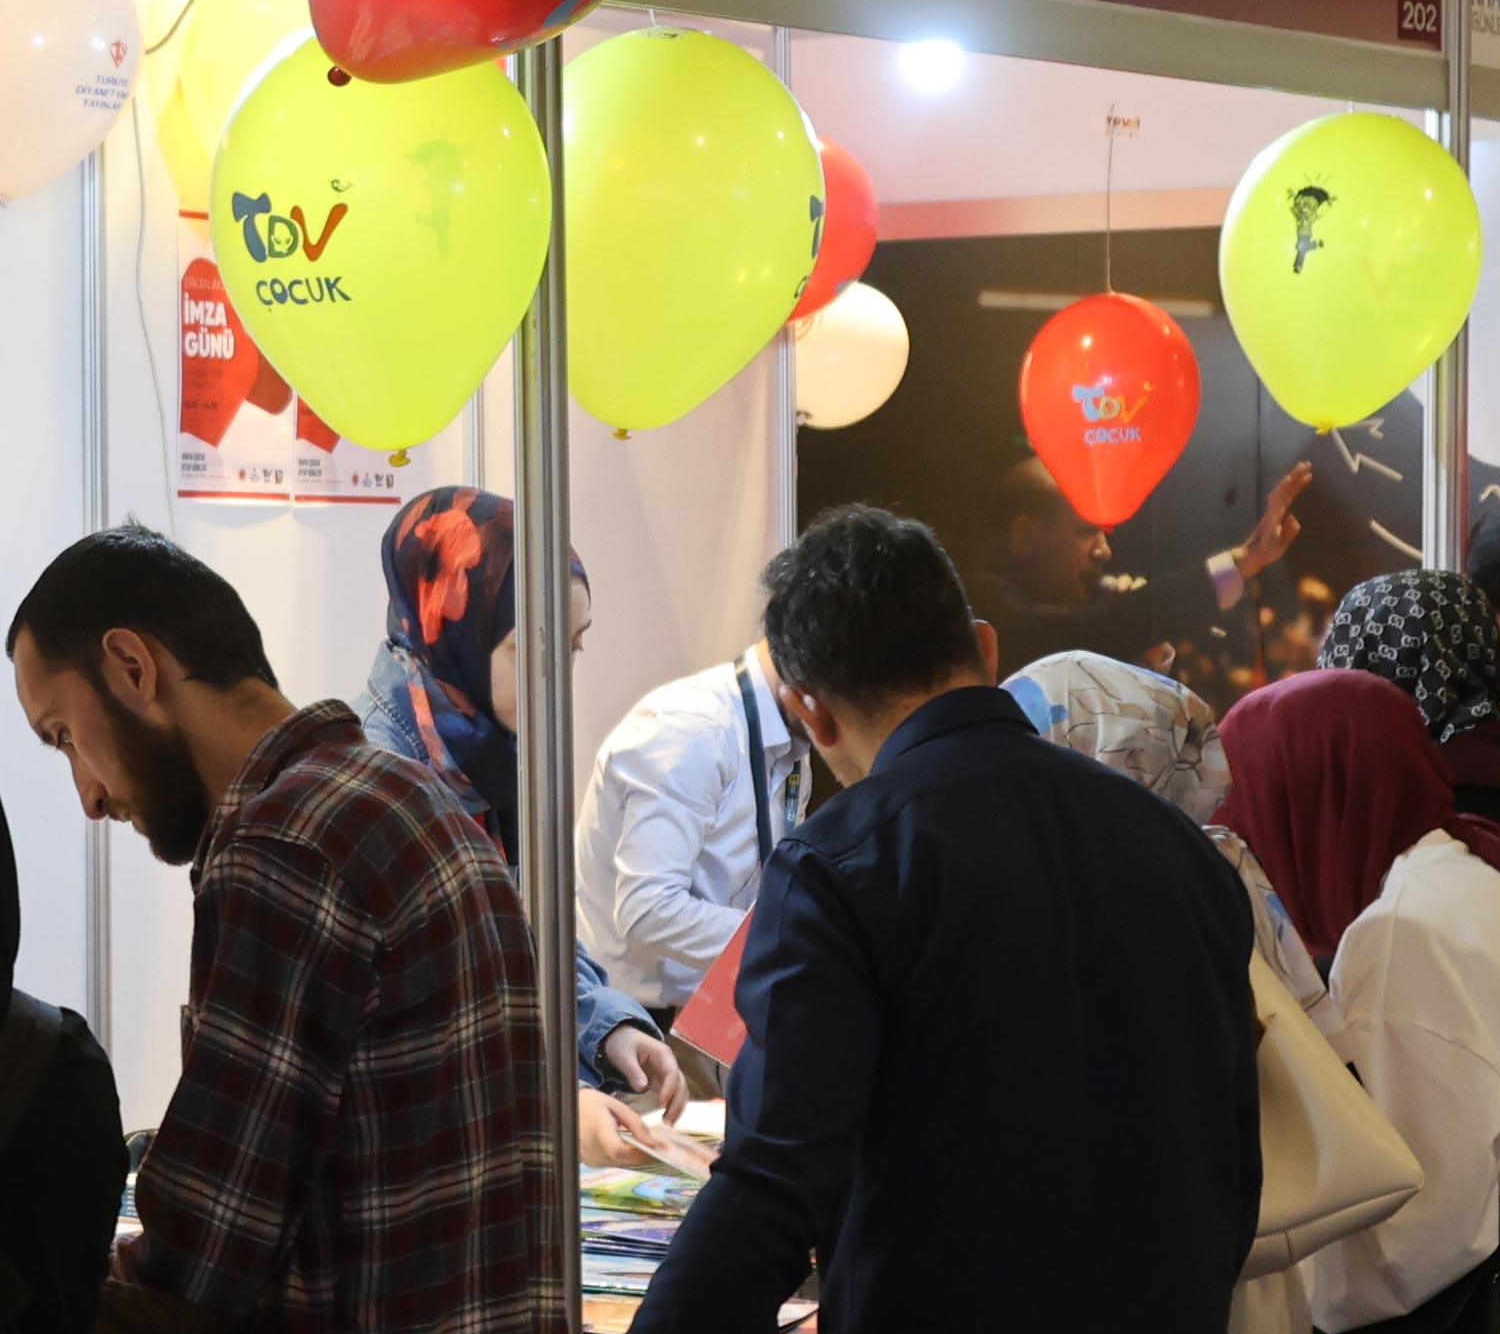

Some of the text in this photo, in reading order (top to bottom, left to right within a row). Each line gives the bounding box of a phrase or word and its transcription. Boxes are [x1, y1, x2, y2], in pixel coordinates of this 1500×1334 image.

[1401, 0, 1438, 34] 202
[231, 191, 349, 263] TDV
[184, 292, 227, 327] İMZA
[255, 275, 353, 313] ÇOCUK
[184, 328, 235, 360] GÜNÜ
[1072, 383, 1149, 423] TDV
[1083, 427, 1144, 448] ÇOCUK
